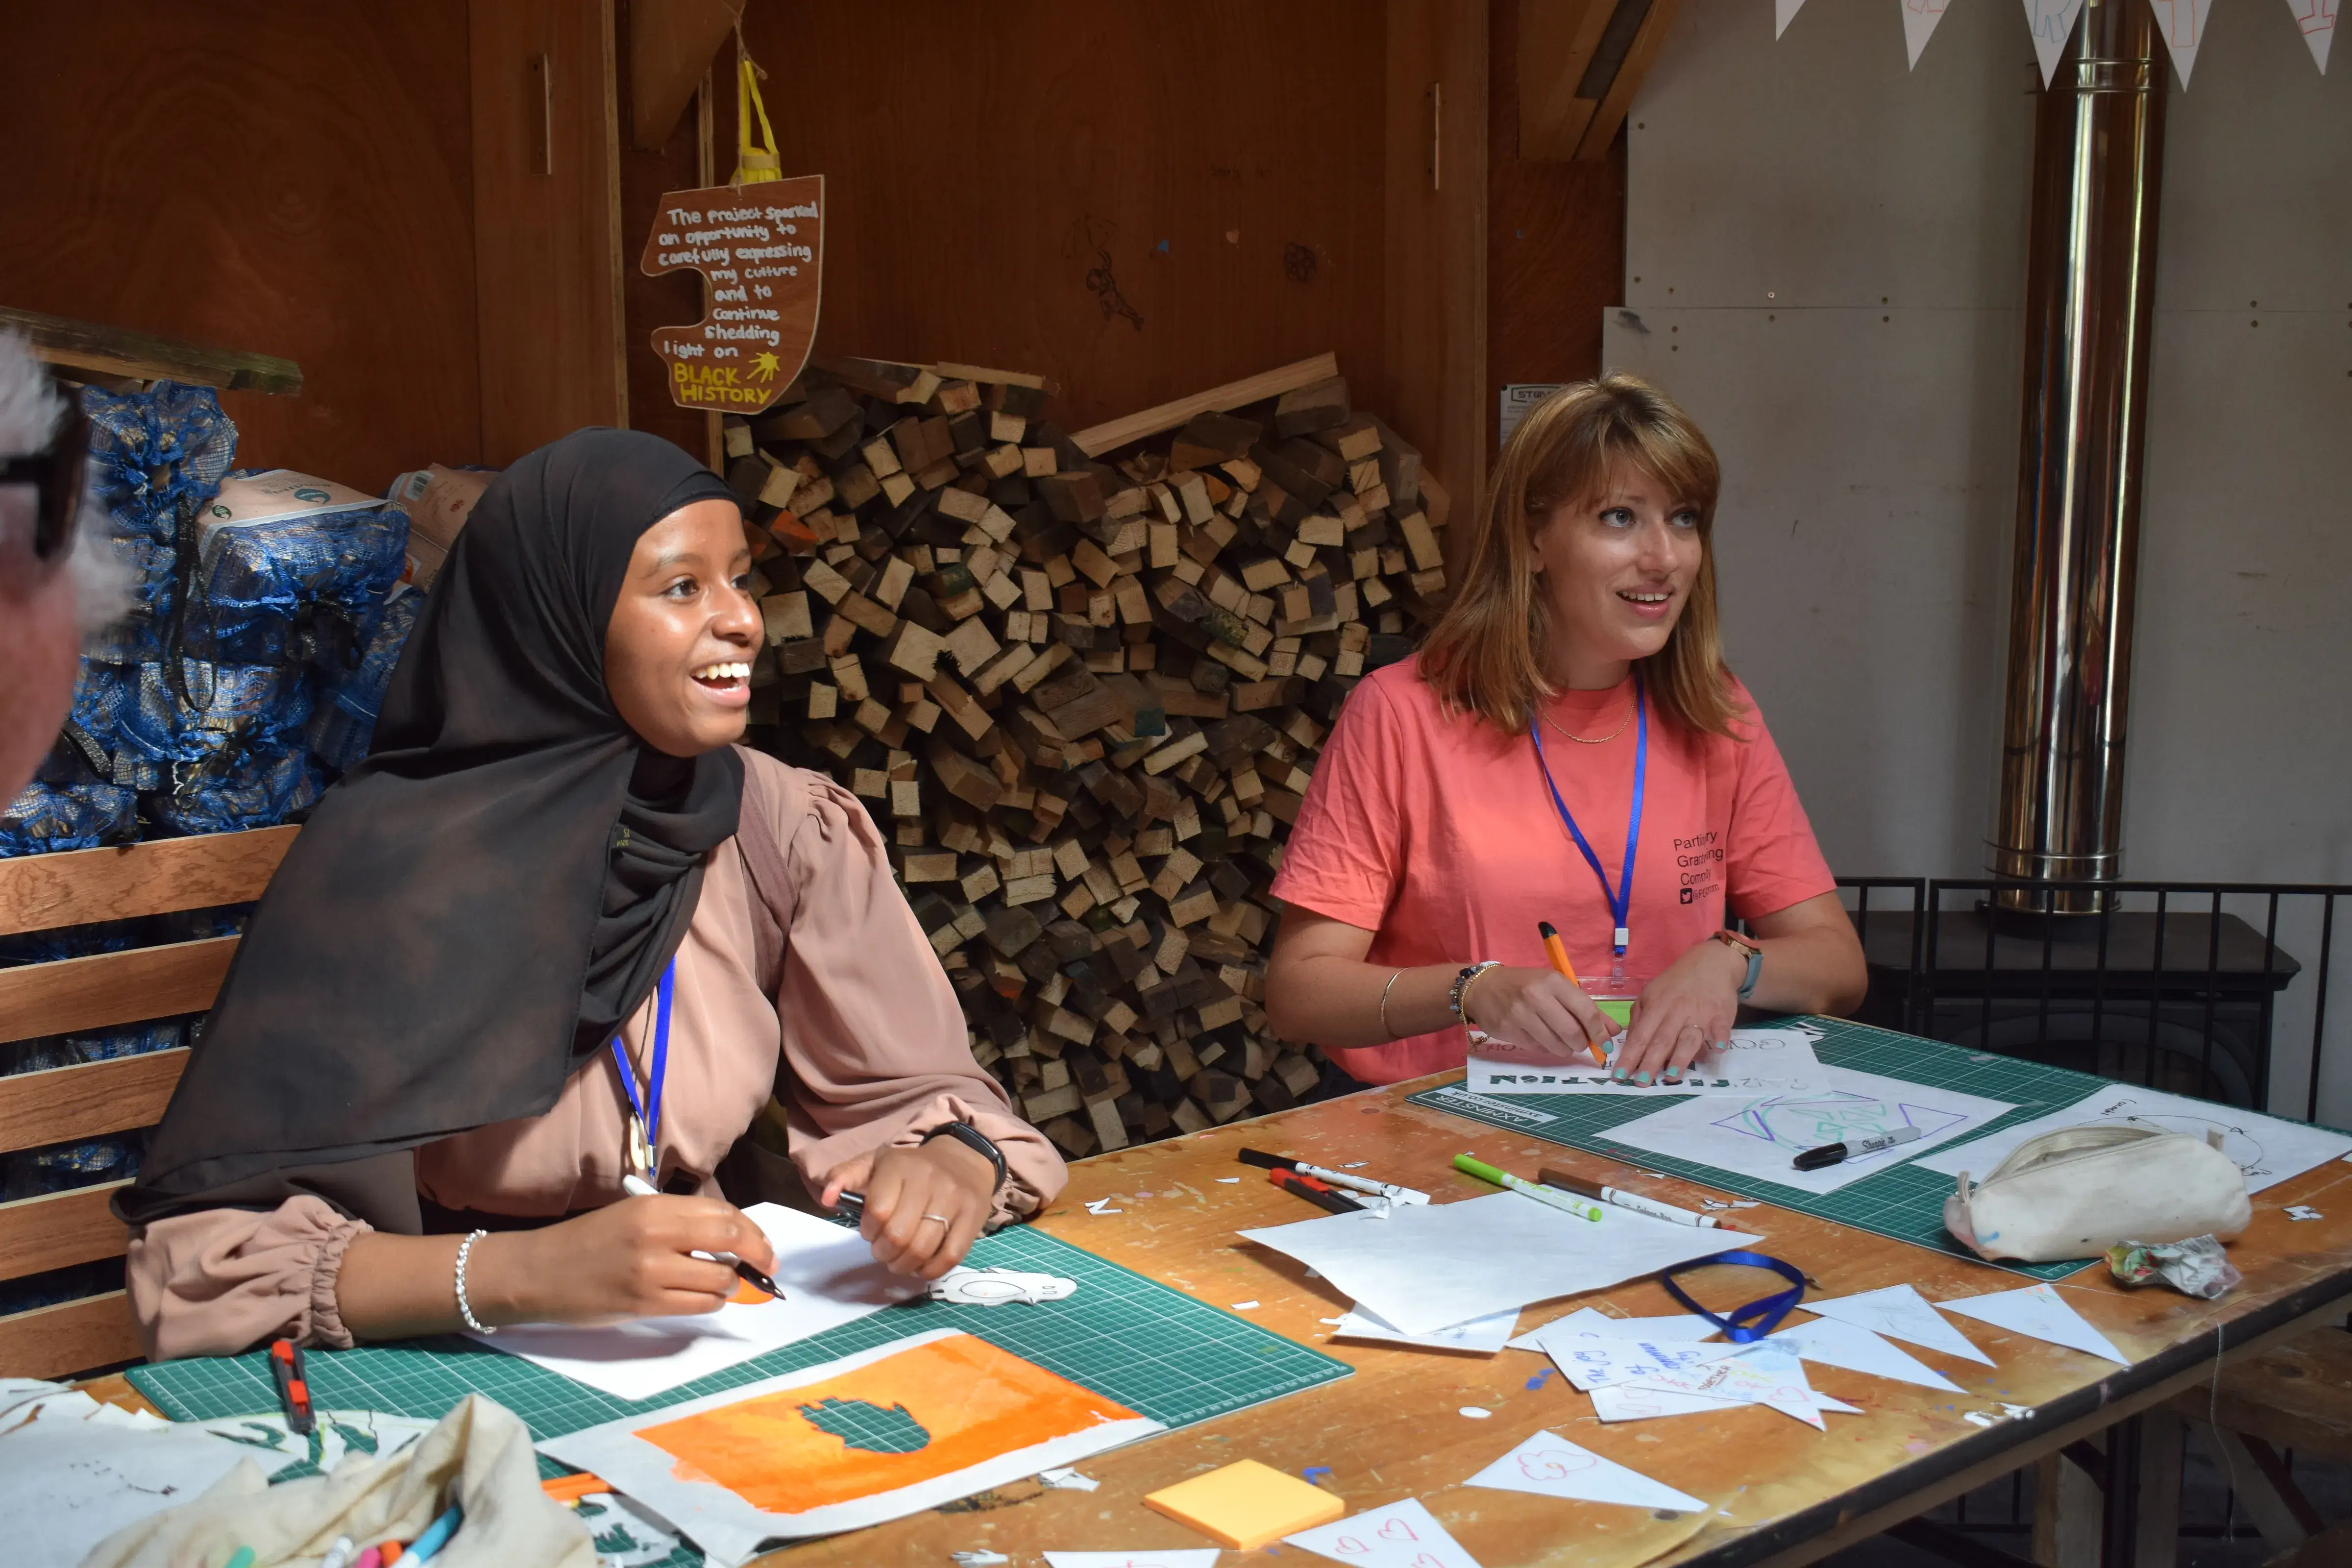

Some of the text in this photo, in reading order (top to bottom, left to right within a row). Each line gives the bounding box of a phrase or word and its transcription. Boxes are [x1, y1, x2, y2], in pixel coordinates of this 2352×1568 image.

[667, 208, 701, 226] The
[659, 223, 796, 246] an opportunity to
[735, 242, 812, 264] expressing
[710, 269, 738, 284] my
[714, 284, 772, 302] and to
[664, 340, 738, 359] light on
[673, 362, 741, 386] BLACK
[680, 385, 772, 404] HISTORY
[1436, 1095, 1529, 1122] AXMINSTER
[1451, 1091, 1543, 1118] axminster.co.uk
[1862, 1137, 1886, 1151] Sharpie
[1572, 1350, 1612, 1383] The joy
[1625, 1364, 1660, 1375] of
[1697, 1365, 1731, 1391] TOGETHER
